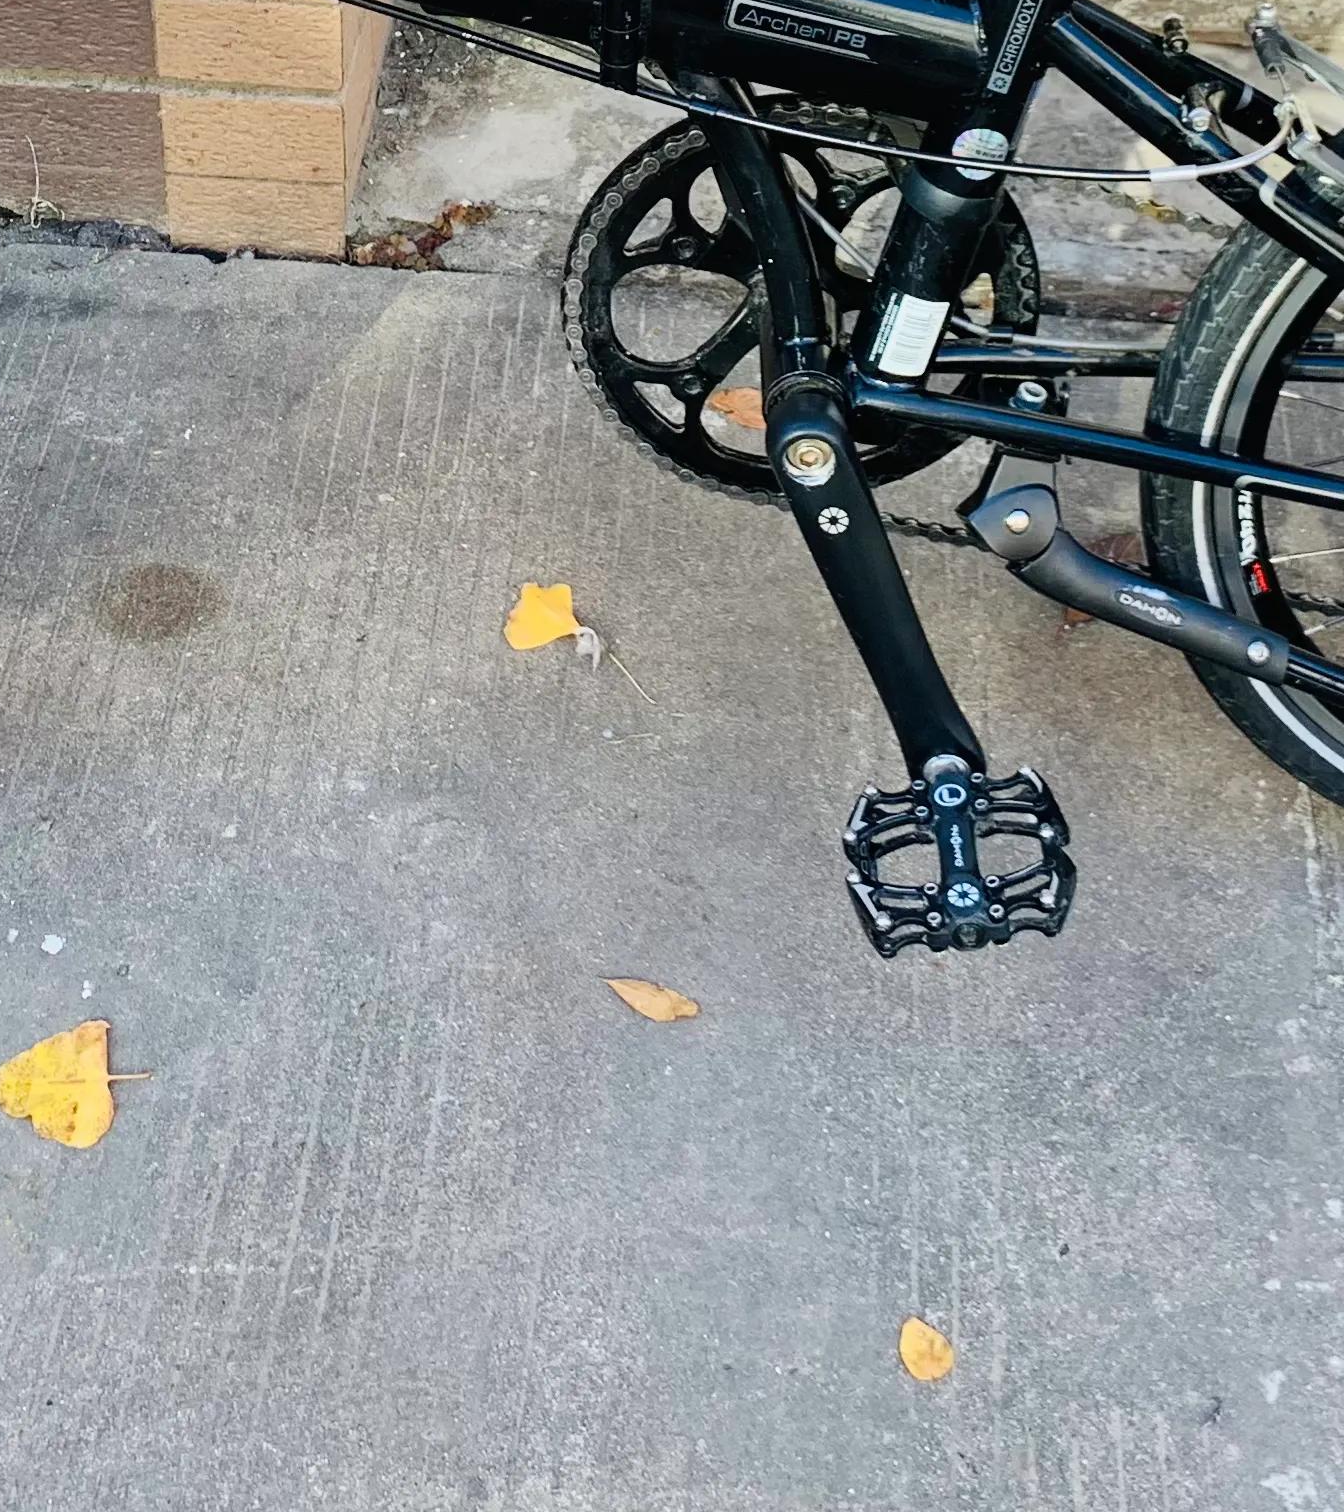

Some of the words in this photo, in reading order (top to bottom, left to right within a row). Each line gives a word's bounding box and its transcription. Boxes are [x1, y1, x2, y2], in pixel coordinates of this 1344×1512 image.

[740, 8, 826, 40] Archer
[834, 31, 866, 48] P8
[1118, 593, 1184, 626] DAHON
